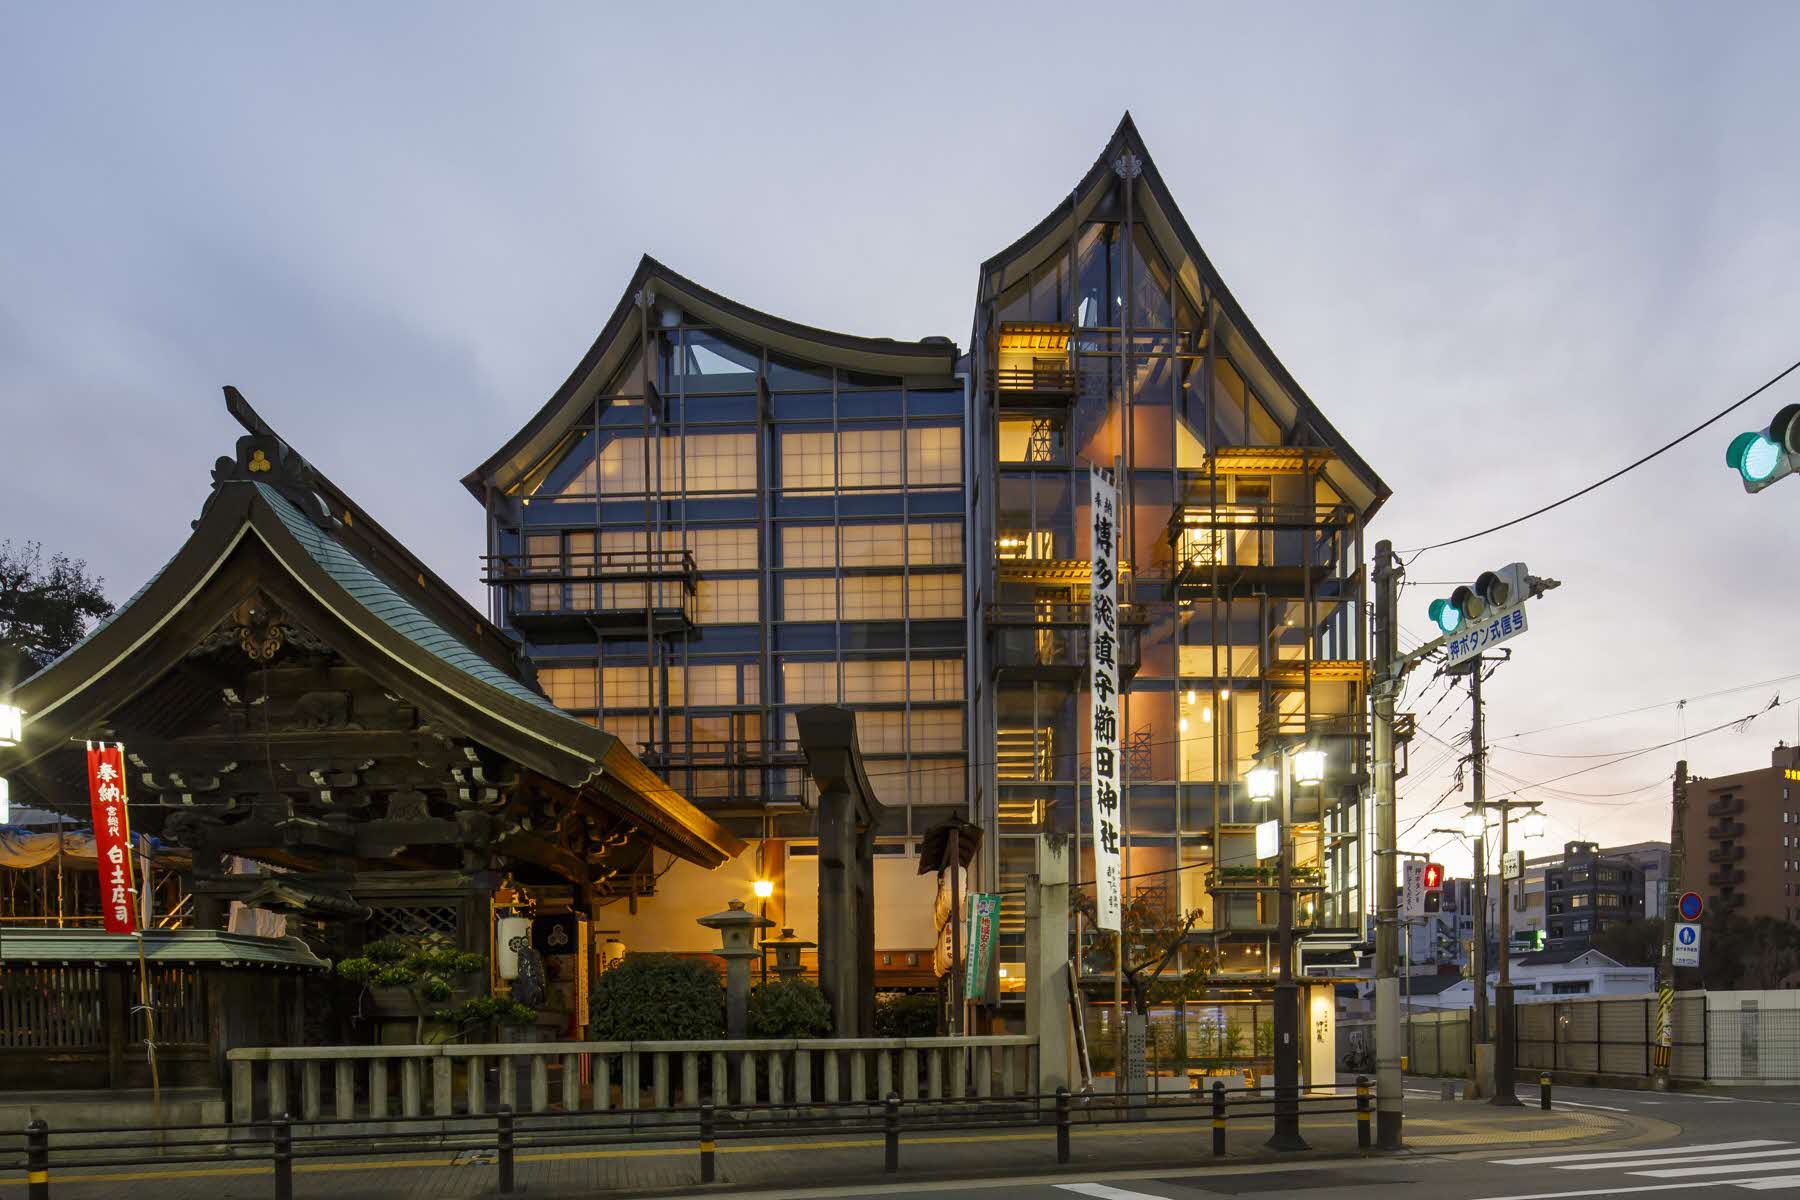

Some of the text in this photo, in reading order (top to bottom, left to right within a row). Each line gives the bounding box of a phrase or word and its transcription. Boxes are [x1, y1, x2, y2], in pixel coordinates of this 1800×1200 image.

[1450, 609, 1523, 660] 押ボタン式信号
[97, 762, 120, 803] 奉納
[107, 844, 128, 924] 白土庄司
